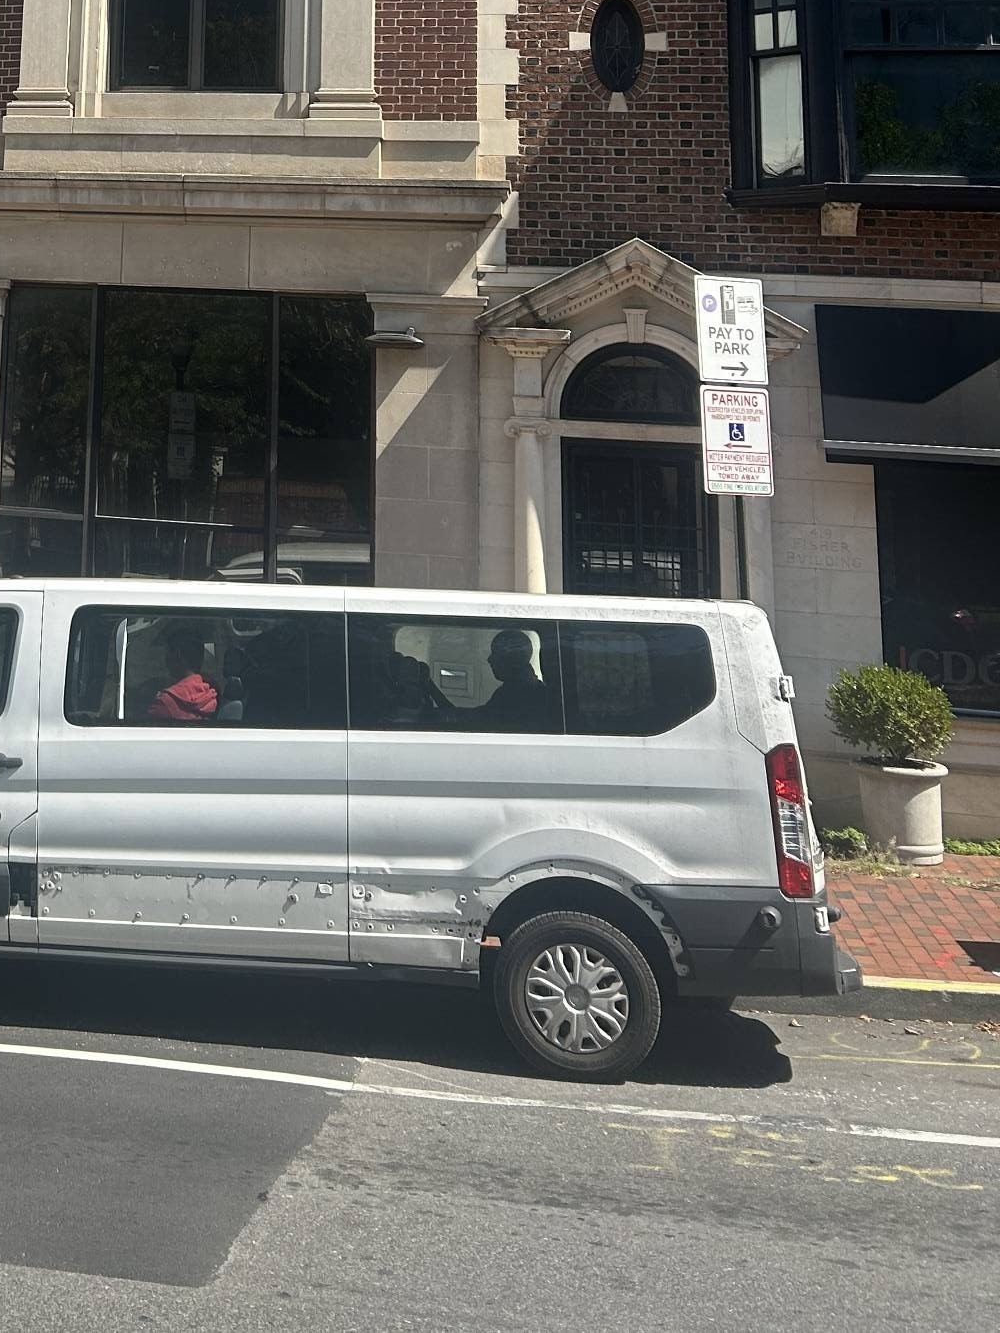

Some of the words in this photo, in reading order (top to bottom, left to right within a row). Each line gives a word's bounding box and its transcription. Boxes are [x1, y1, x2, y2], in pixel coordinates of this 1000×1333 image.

[708, 327, 733, 339] PAY
[736, 328, 754, 341] TO
[714, 342, 750, 355] PARK
[712, 394, 758, 407] PARKING
[711, 464, 733, 472] OTHER
[734, 466, 766, 474] VEHICLES
[793, 538, 851, 554] FISHER
